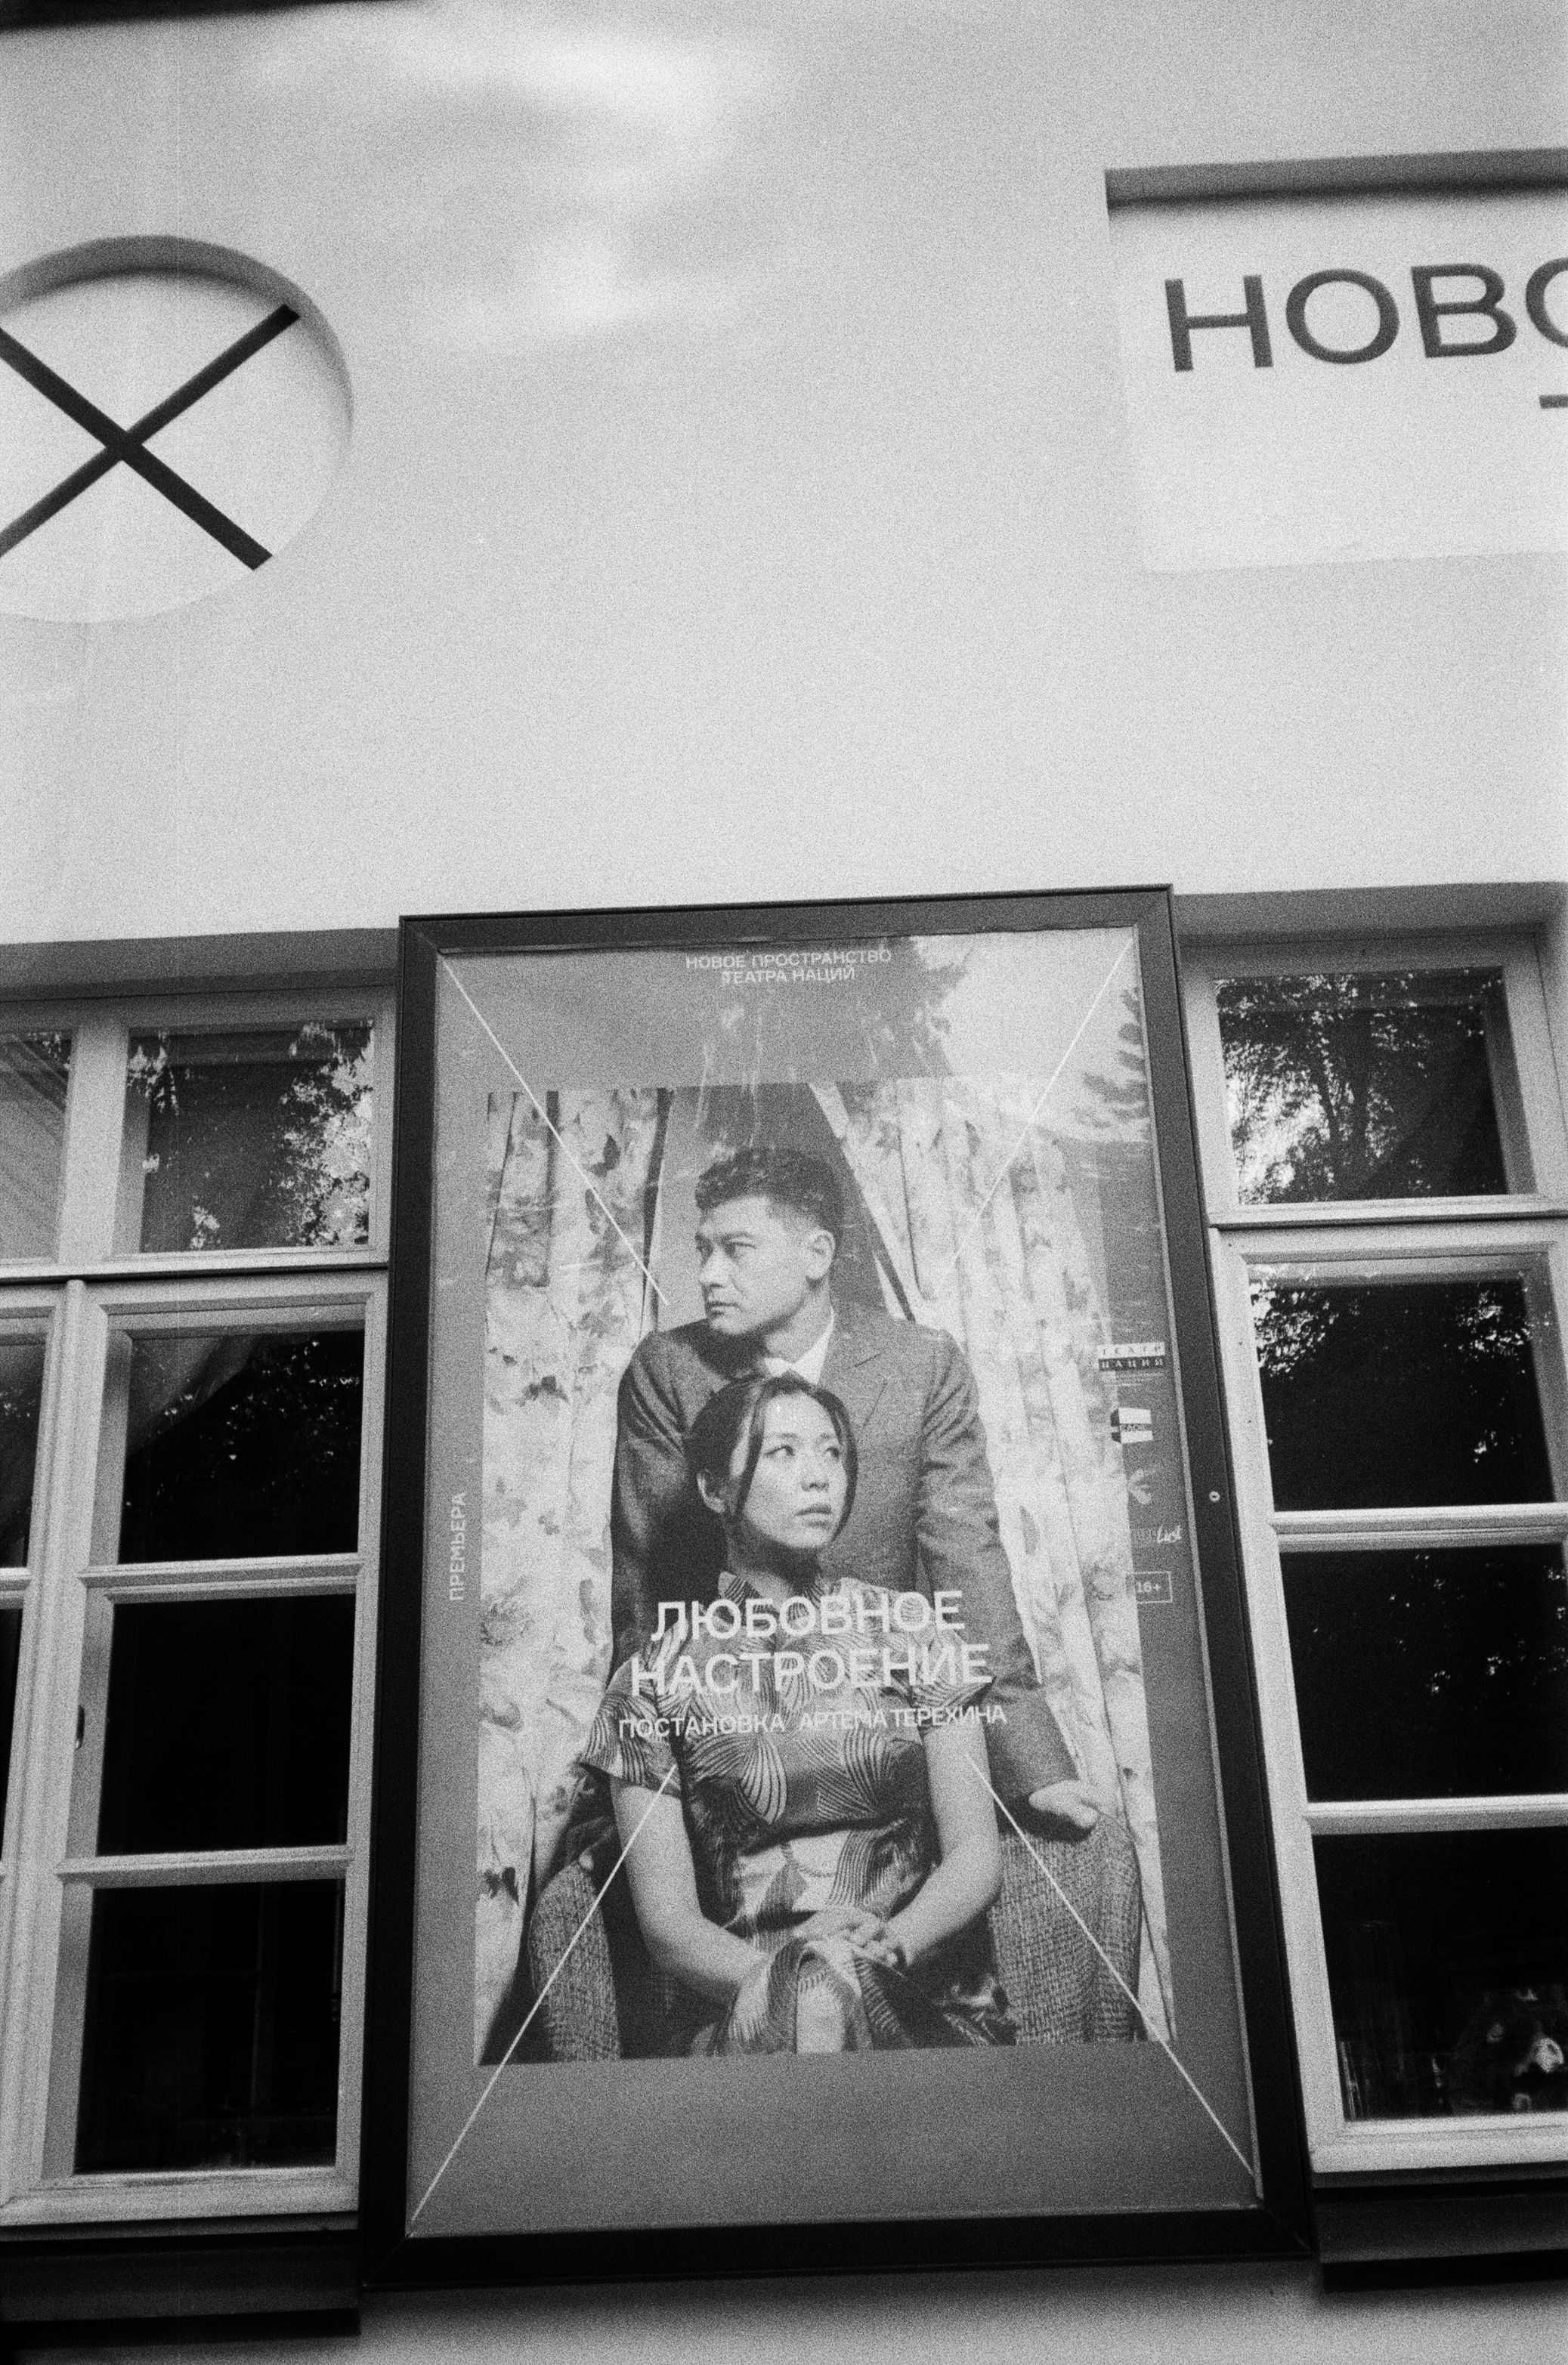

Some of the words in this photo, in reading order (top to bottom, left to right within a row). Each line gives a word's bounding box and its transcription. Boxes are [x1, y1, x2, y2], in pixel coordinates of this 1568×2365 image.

[685, 955, 747, 969] НОВОЕ
[752, 949, 892, 968] ПРОСТРАНСТВО
[721, 970, 789, 985] ТЕАТРА
[793, 965, 856, 983] НАЦИЙ
[449, 1492, 466, 1601] ПРЕМЬЕРА
[651, 1590, 966, 1643] ЛЮБОВНОЕ
[630, 1643, 994, 1697] НАСТРОЕНИЕ
[619, 1714, 787, 1739] ПОСТАНОВКА
[890, 1704, 1008, 1729] ТЕРЕХИНА
